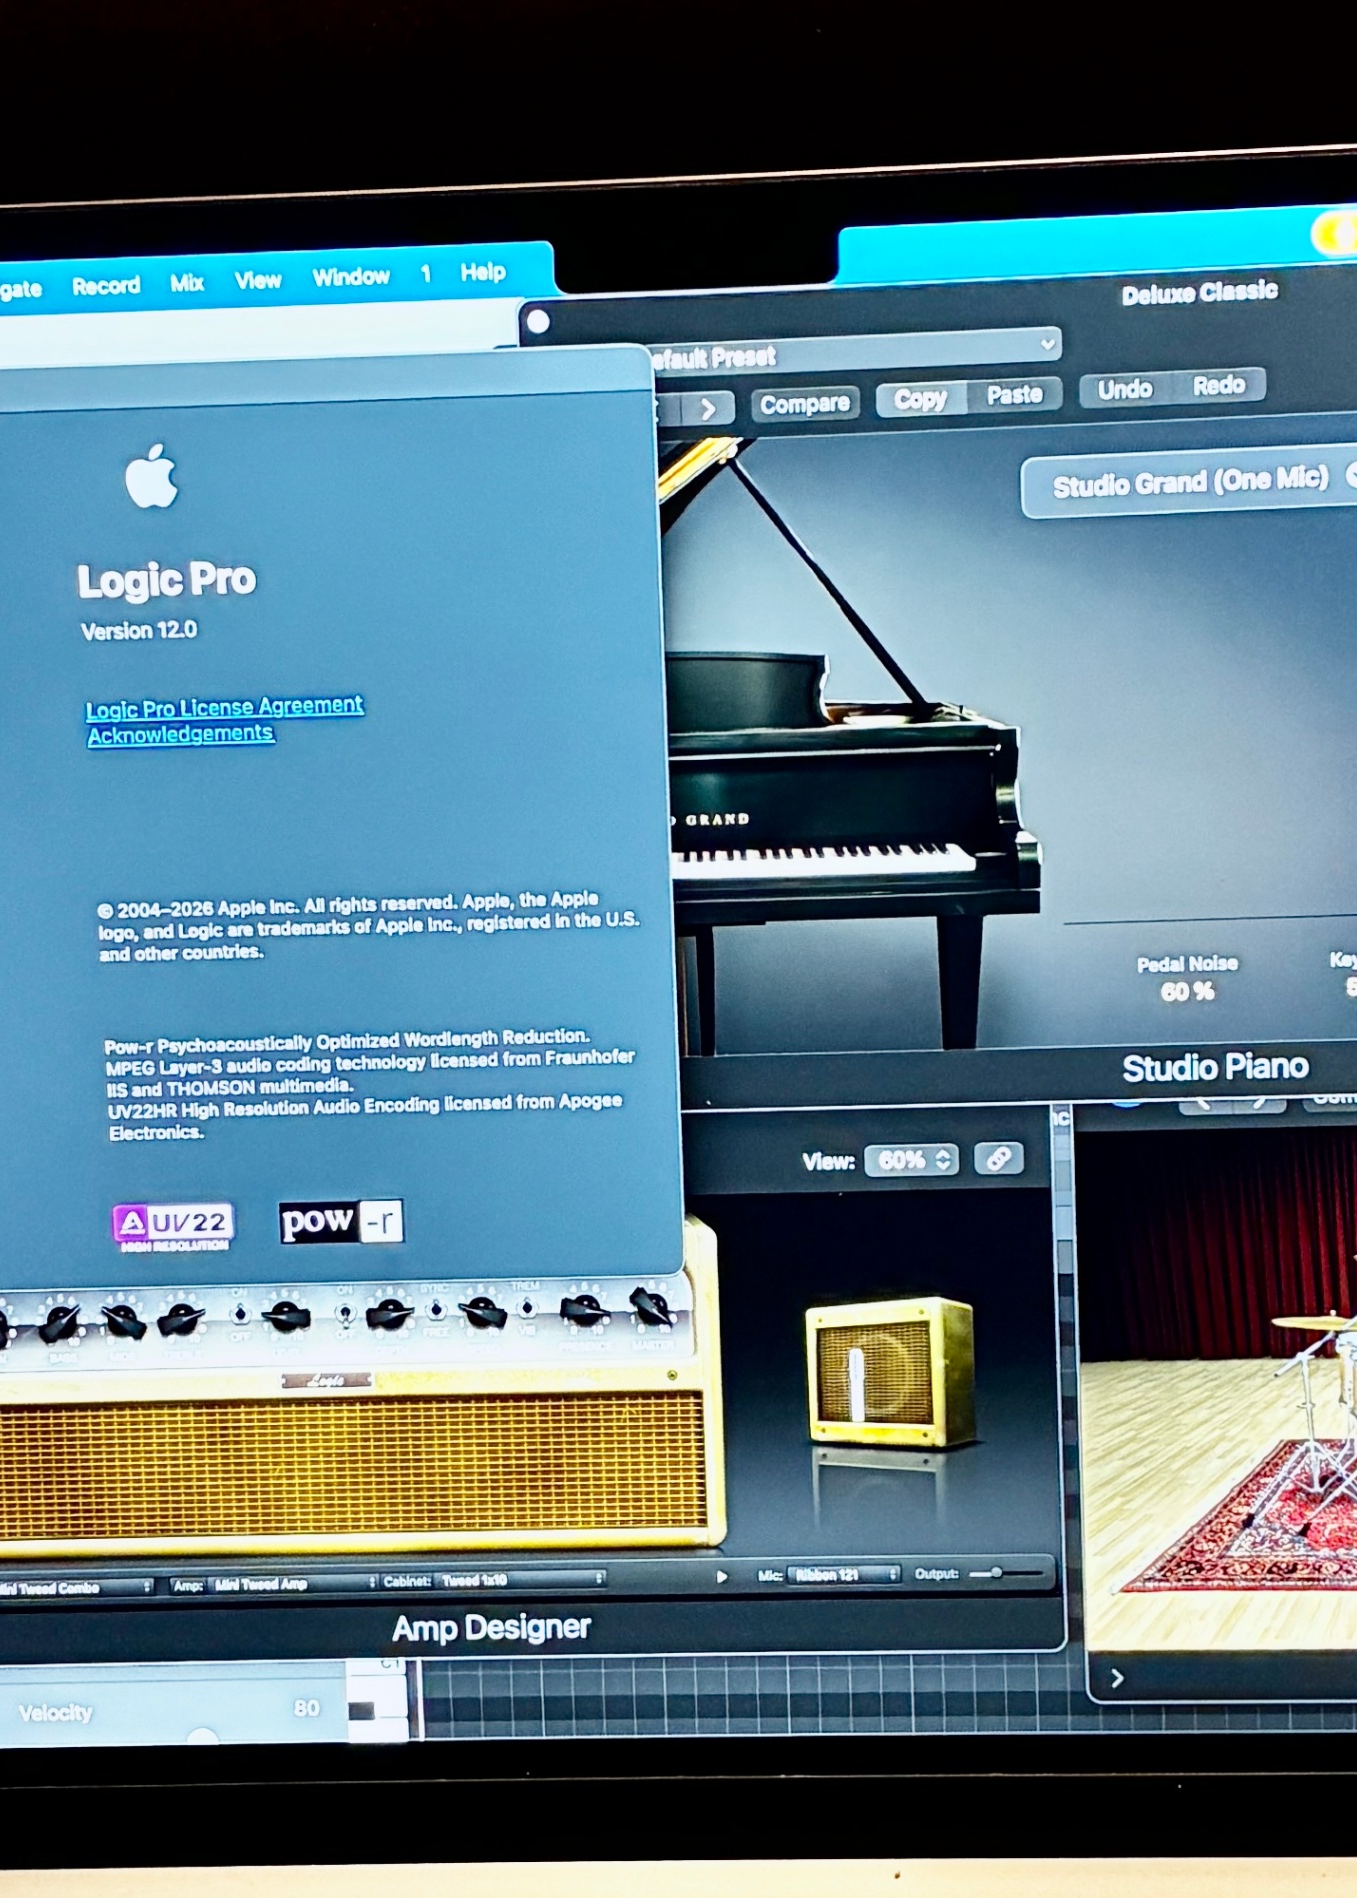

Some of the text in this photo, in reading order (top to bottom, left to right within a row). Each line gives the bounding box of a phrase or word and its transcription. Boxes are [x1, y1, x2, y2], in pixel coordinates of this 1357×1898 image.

[73, 275, 141, 297] Record
[171, 273, 205, 292] Mix
[235, 271, 283, 290] View
[313, 267, 390, 288] Window
[421, 264, 432, 284] 1
[461, 262, 507, 284] Help
[1122, 279, 1279, 306] Deluxe Classic
[712, 345, 776, 368] Preset
[987, 385, 1043, 407] Paste
[1098, 378, 1154, 401] Undo
[1194, 375, 1246, 397] Redo
[760, 393, 851, 417] Compare
[894, 389, 948, 413] Copy
[1054, 464, 1330, 499] Studio Grand (One Mic)
[78, 560, 257, 604] Logic Pro
[81, 619, 198, 641] Version 12.0
[86, 694, 364, 721] Logic Pro License Agreement
[88, 723, 274, 747] Acknowledgements
[217, 899, 266, 918] Apple
[270, 899, 300, 915] Inc.
[304, 897, 325, 914] All
[329, 896, 377, 915] rights
[381, 893, 458, 912] reserved.
[462, 893, 515, 912] Apple,
[519, 891, 546, 908] the
[551, 889, 599, 909] Apple
[99, 910, 640, 943] logo, and Logic are trademarks of Apple Inc., registered in the U.S.
[99, 943, 265, 963] and other countries.
[1137, 953, 1239, 973] Pedal Noise
[104, 1028, 591, 1056] Pow-r Psychoacoustically Optimized Wordlength Reduction.
[106, 1048, 636, 1078] MPEG Layer-3 audio coding technology licensed from Fraunhofer
[1122, 1050, 1310, 1083] Studio Piano
[131, 1081, 163, 1098] and
[166, 1079, 256, 1097] THOMSON
[259, 1077, 355, 1095] multimedia.
[108, 1092, 623, 1121] UV22HR High Resolution Audio Encoding licensed from Apogee
[109, 1123, 205, 1142] Electronics.
[802, 1149, 927, 1172] View: 60%
[392, 1612, 593, 1646] Amp Designer
